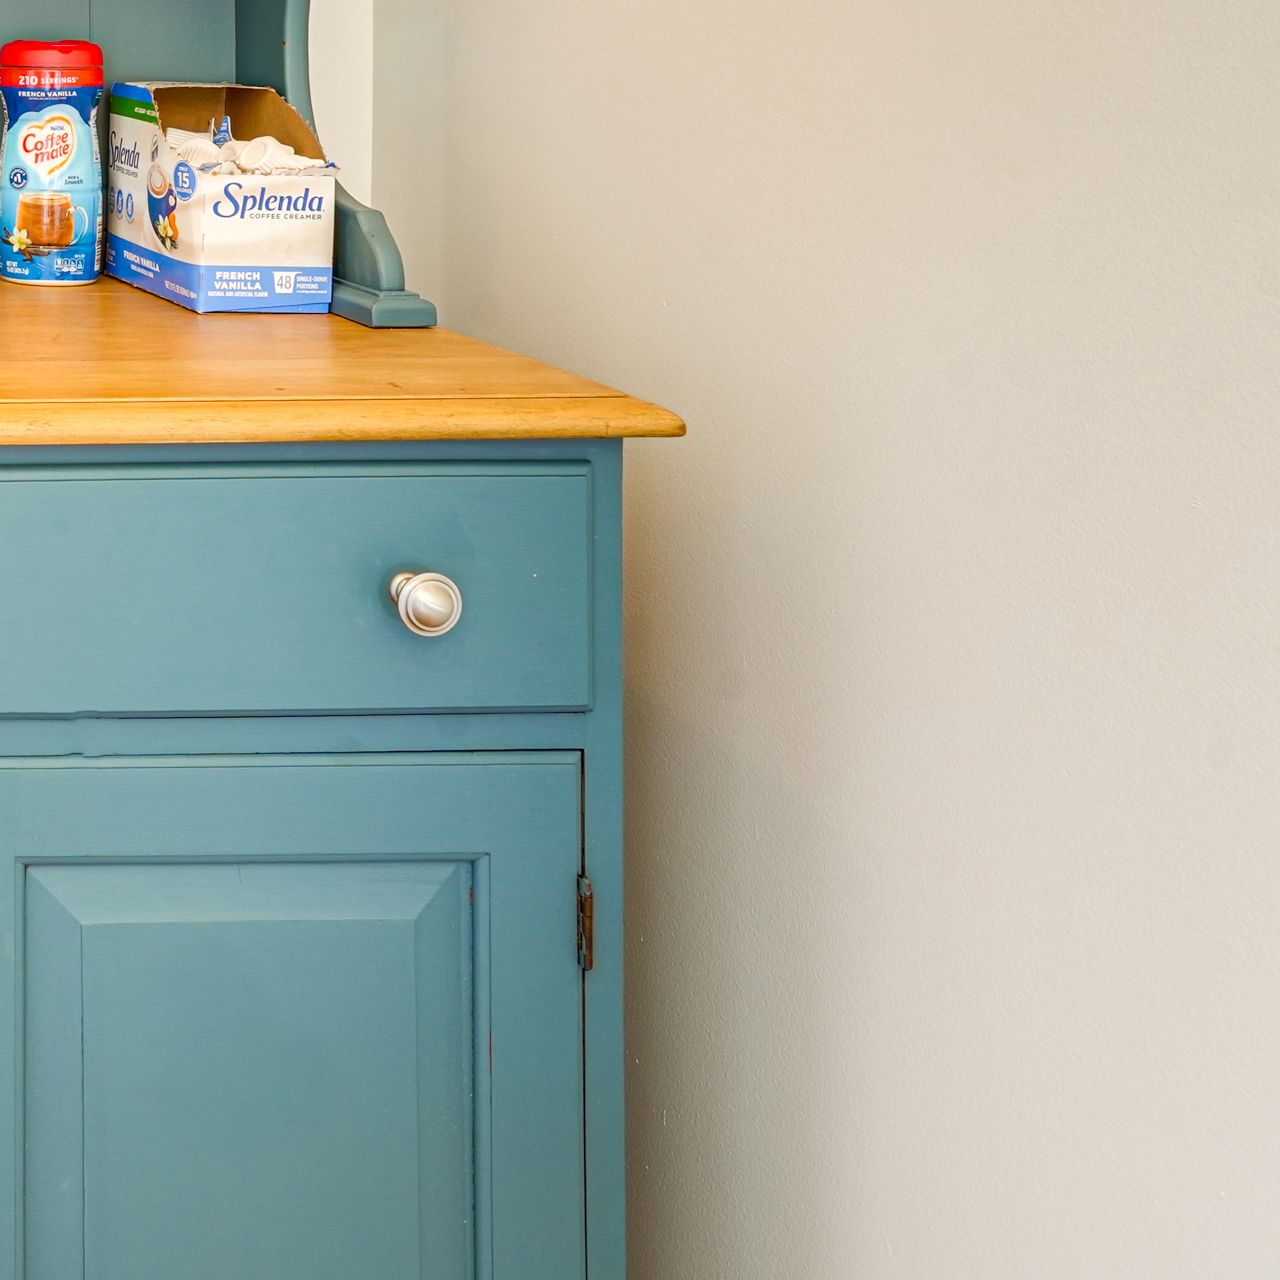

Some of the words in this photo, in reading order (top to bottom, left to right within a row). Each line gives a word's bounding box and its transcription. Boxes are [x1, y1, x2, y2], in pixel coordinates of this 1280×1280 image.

[18, 75, 38, 86] 210
[22, 132, 69, 153] Coffee
[109, 130, 140, 171] Splenda
[34, 143, 70, 164] mate
[177, 171, 189, 188] 15
[212, 182, 322, 219] Splenda
[215, 271, 261, 281] FRENCH
[276, 275, 292, 290] 48
[214, 281, 262, 290] VANILLA
